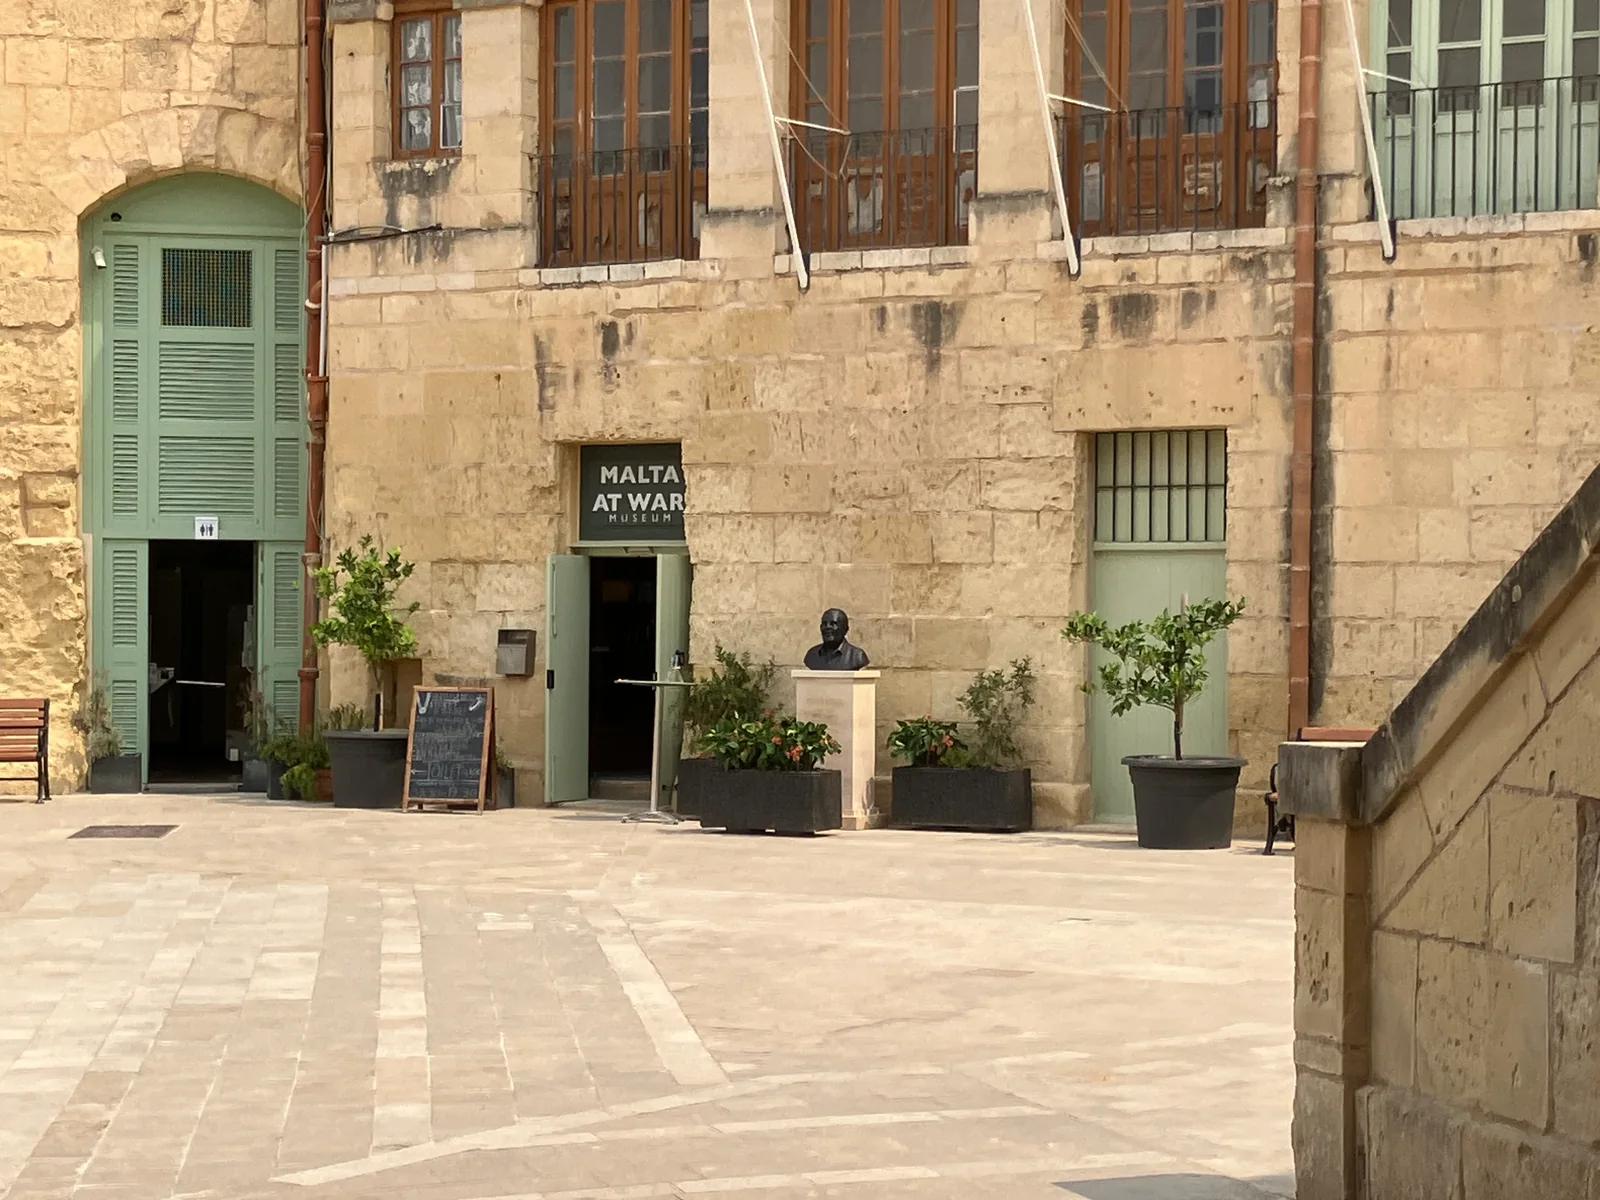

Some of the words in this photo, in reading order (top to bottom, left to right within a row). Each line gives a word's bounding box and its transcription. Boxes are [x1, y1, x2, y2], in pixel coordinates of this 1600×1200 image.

[600, 465, 680, 484] MALTA
[592, 494, 623, 512] AT
[627, 493, 684, 511] WAR
[608, 513, 672, 523] MUSEUM
